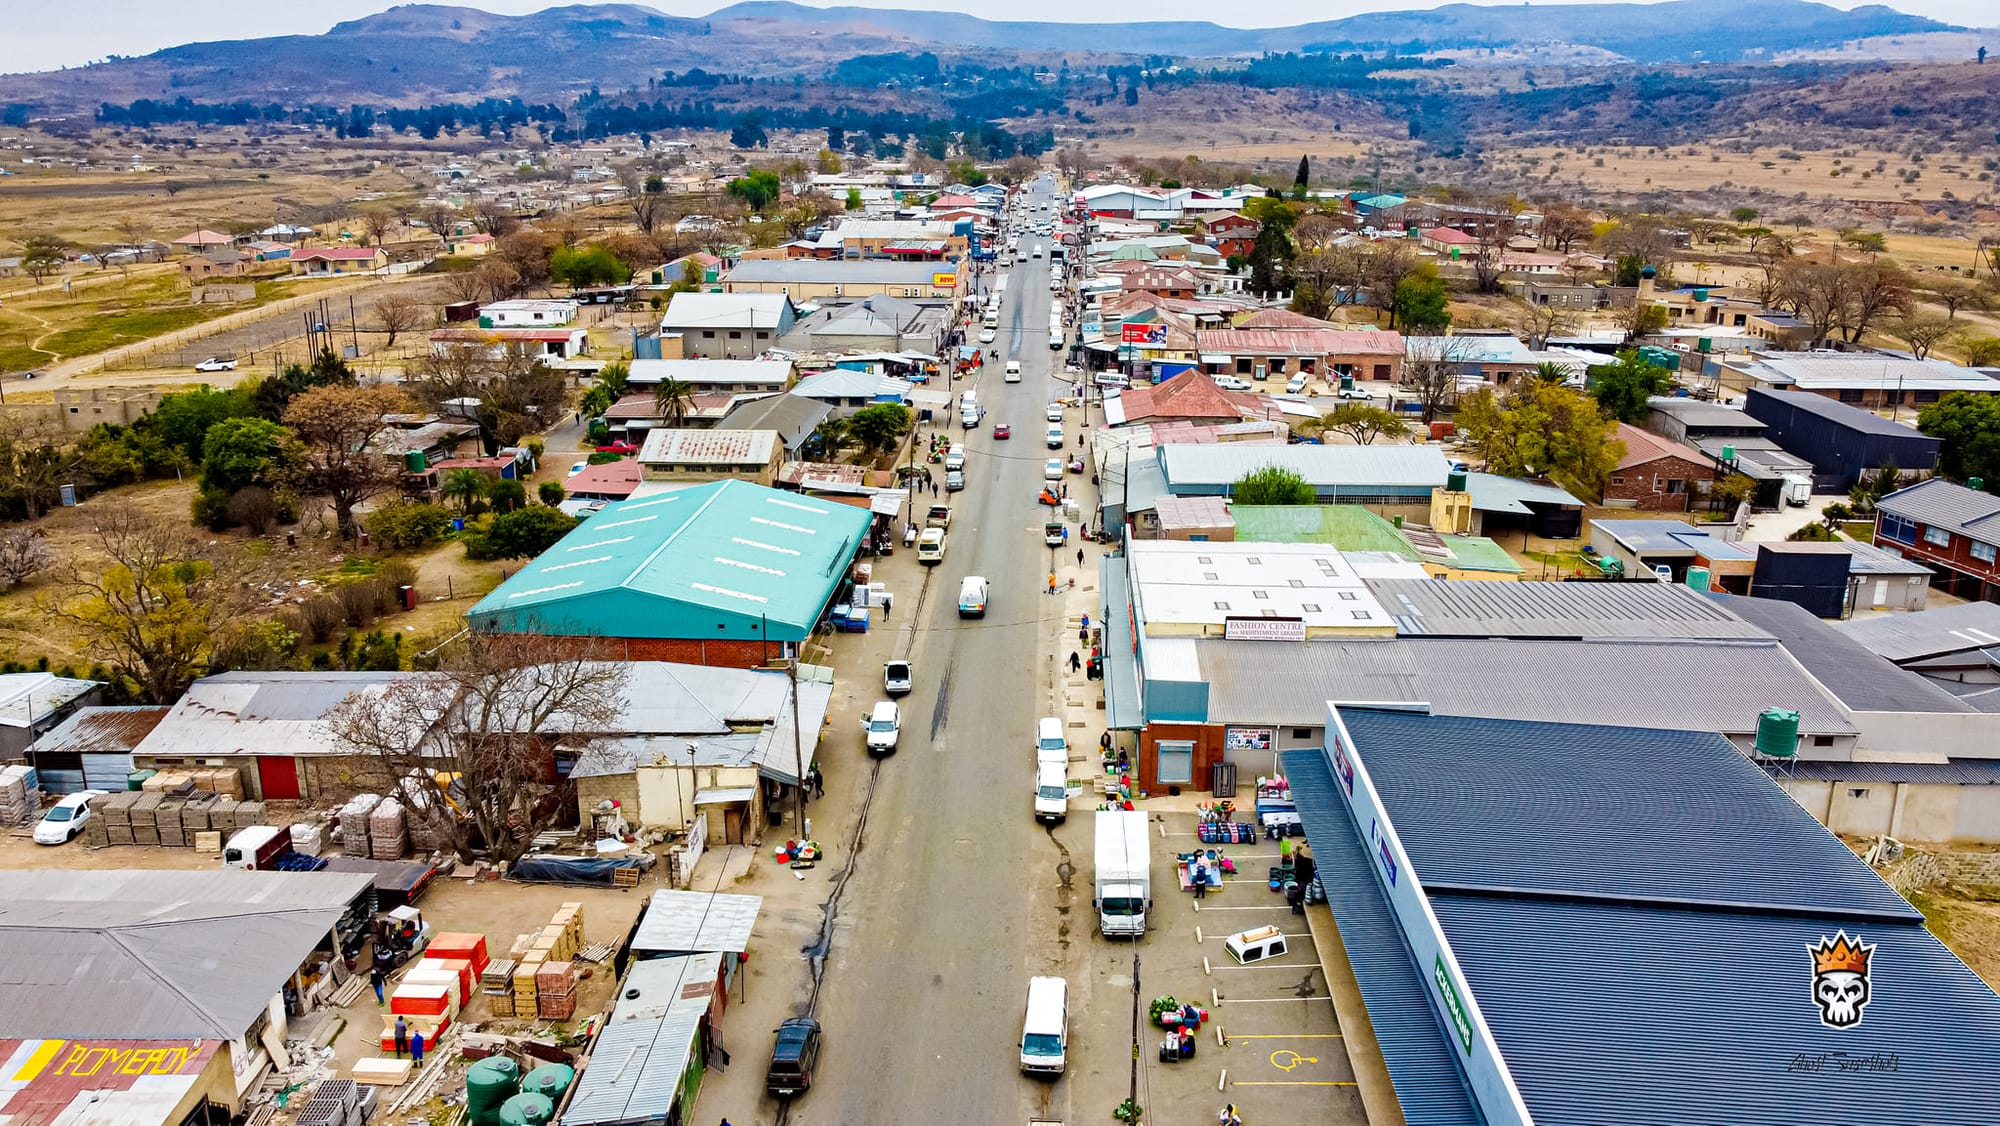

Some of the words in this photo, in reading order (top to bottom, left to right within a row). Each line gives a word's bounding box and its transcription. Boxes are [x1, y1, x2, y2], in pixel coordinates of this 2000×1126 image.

[1230, 622, 1266, 630] FASHION
[1269, 622, 1303, 631] CENTRE
[1435, 963, 1470, 1046] ACKERMANS
